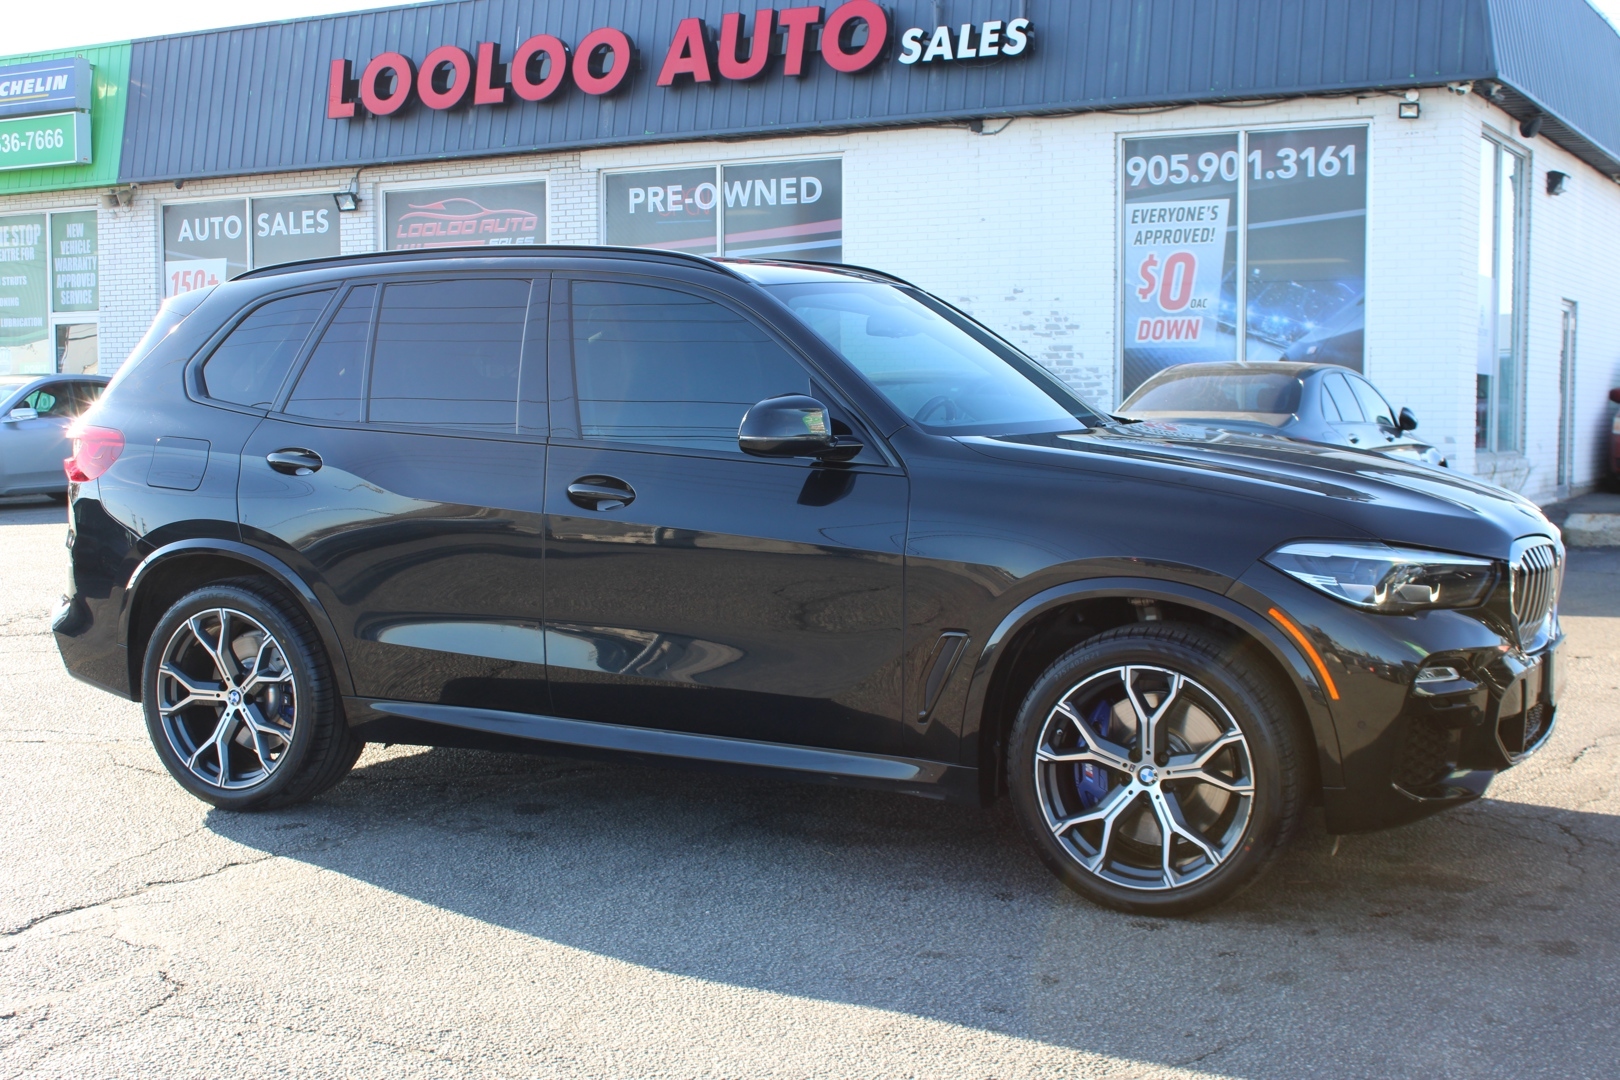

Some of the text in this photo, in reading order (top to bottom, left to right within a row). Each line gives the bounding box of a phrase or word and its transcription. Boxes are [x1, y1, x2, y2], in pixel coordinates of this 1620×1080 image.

[328, 0, 1030, 119] LOOLOO AUTO SALES
[0, 74, 68, 97] CHELIN
[0, 128, 64, 153] 36-7666
[1126, 145, 1356, 186] 905.901.3161
[628, 176, 823, 214] PRE-OWNED
[178, 209, 329, 242] AUTO SALES
[1131, 205, 1219, 225] EVERYONE'S
[11, 224, 41, 246] STOP
[66, 223, 84, 238] NEW
[396, 216, 538, 239] LOOLOO AUTO
[1133, 227, 1216, 246] APPROVED!
[20, 247, 35, 261] FOR
[60, 240, 91, 255] VEHICLE
[54, 256, 98, 272] WARRANTY
[1, 276, 28, 286] STRUTS
[56, 273, 96, 289] APPROVED
[1138, 252, 1196, 310] $0
[60, 289, 93, 305] SERVICE
[1190, 298, 1208, 309] OAC
[1137, 319, 1201, 341] DOWN
